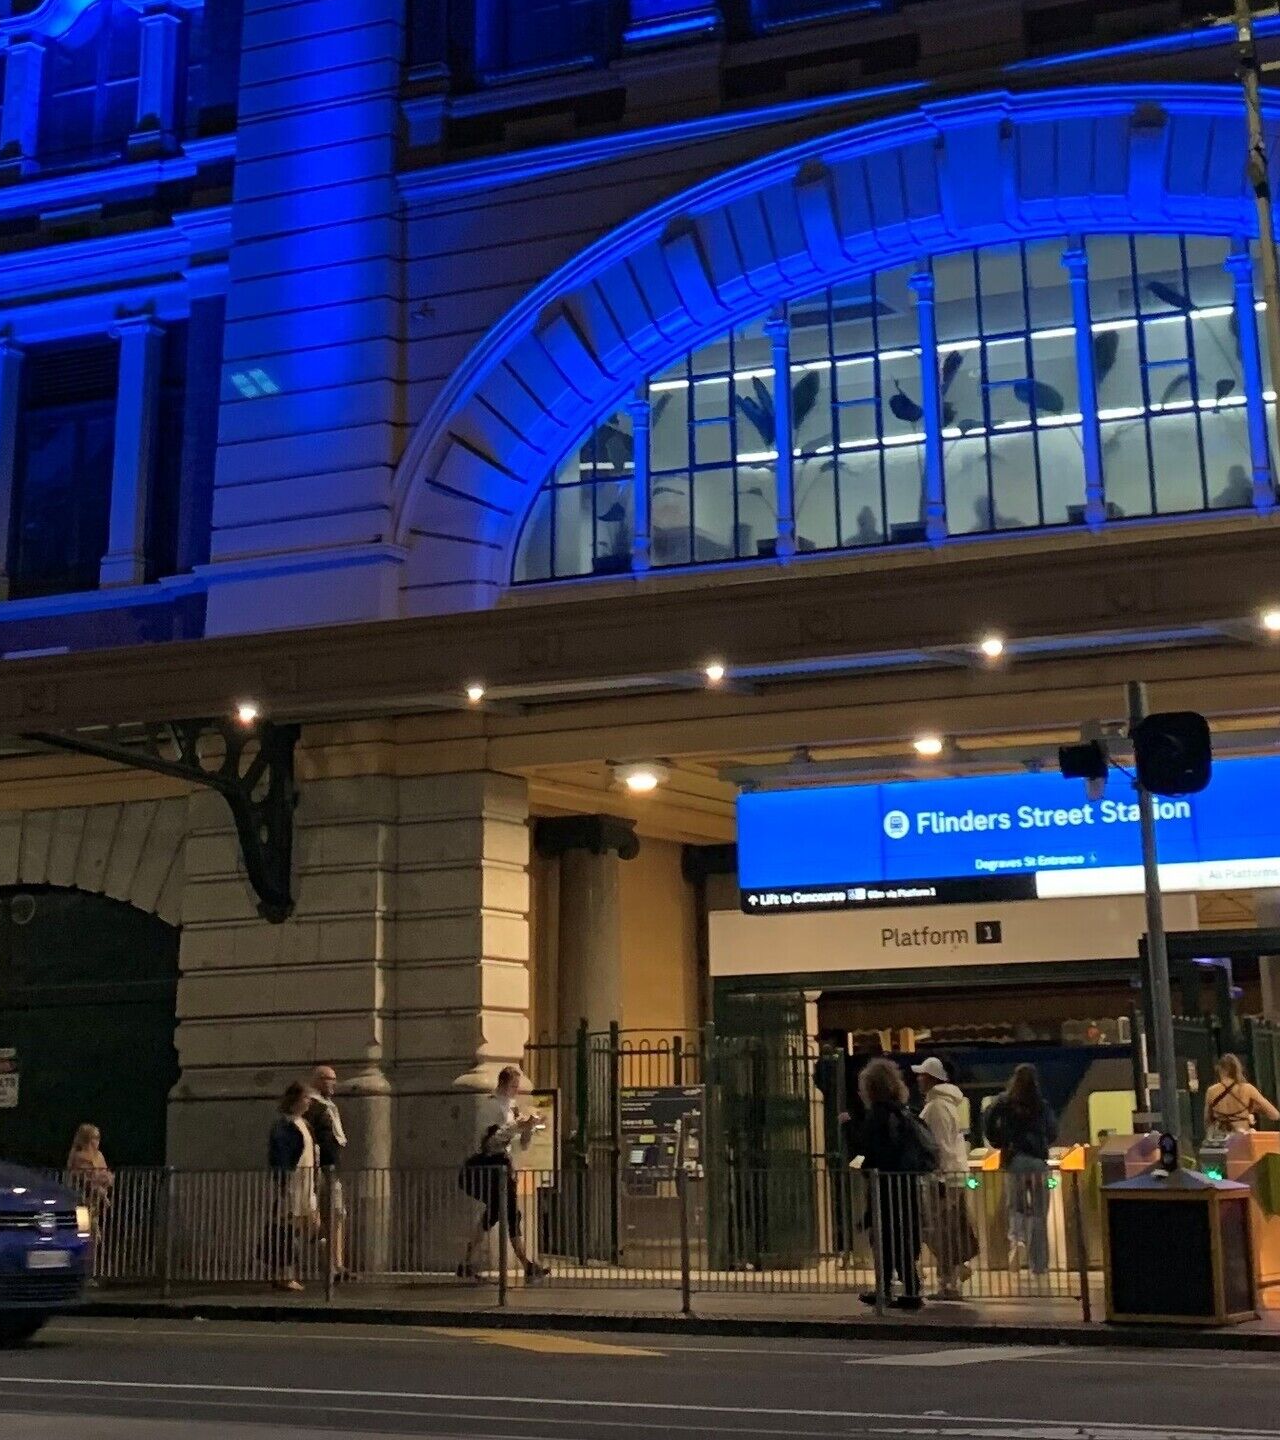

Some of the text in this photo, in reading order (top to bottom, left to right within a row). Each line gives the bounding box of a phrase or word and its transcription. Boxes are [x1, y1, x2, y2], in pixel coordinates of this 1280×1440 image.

[916, 797, 1191, 835] Flinders Street Staion
[975, 854, 1085, 871] Degraves St Entrance
[760, 893, 780, 905] Lift
[780, 893, 792, 905] to
[793, 891, 846, 903] Concourse
[881, 926, 969, 948] Platform
